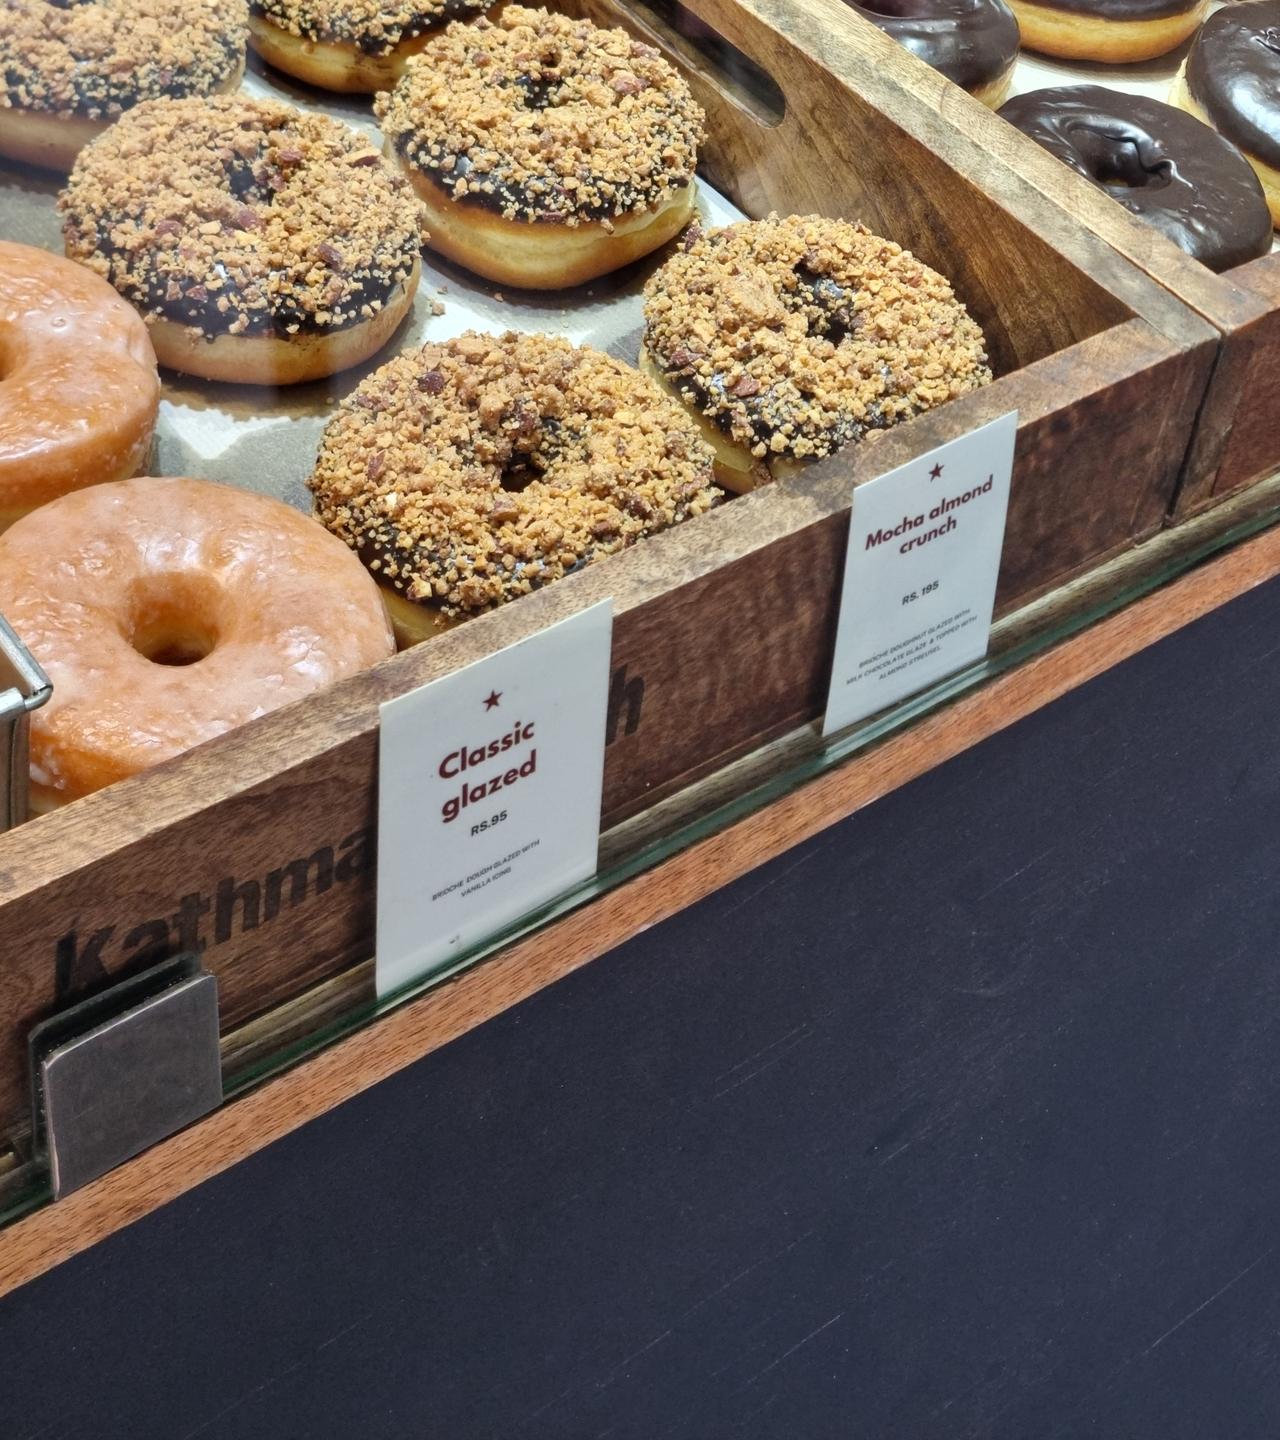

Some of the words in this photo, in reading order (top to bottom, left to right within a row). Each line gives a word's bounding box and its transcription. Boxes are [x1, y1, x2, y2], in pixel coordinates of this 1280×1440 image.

[865, 513, 924, 551] Mocha
[929, 474, 993, 519] almond
[899, 516, 957, 555] crunch
[902, 592, 920, 606] RS.
[921, 580, 940, 595] 195
[438, 720, 535, 780] Classic
[441, 749, 537, 824] glazed
[470, 810, 508, 837] RS.95
[432, 879, 464, 901] BRIOCHE
[465, 865, 493, 884] DOUGH
[493, 849, 522, 869] GLAZED
[521, 839, 541, 855] WITH
[460, 878, 491, 898] VANILLA
[491, 867, 512, 884] ICING
